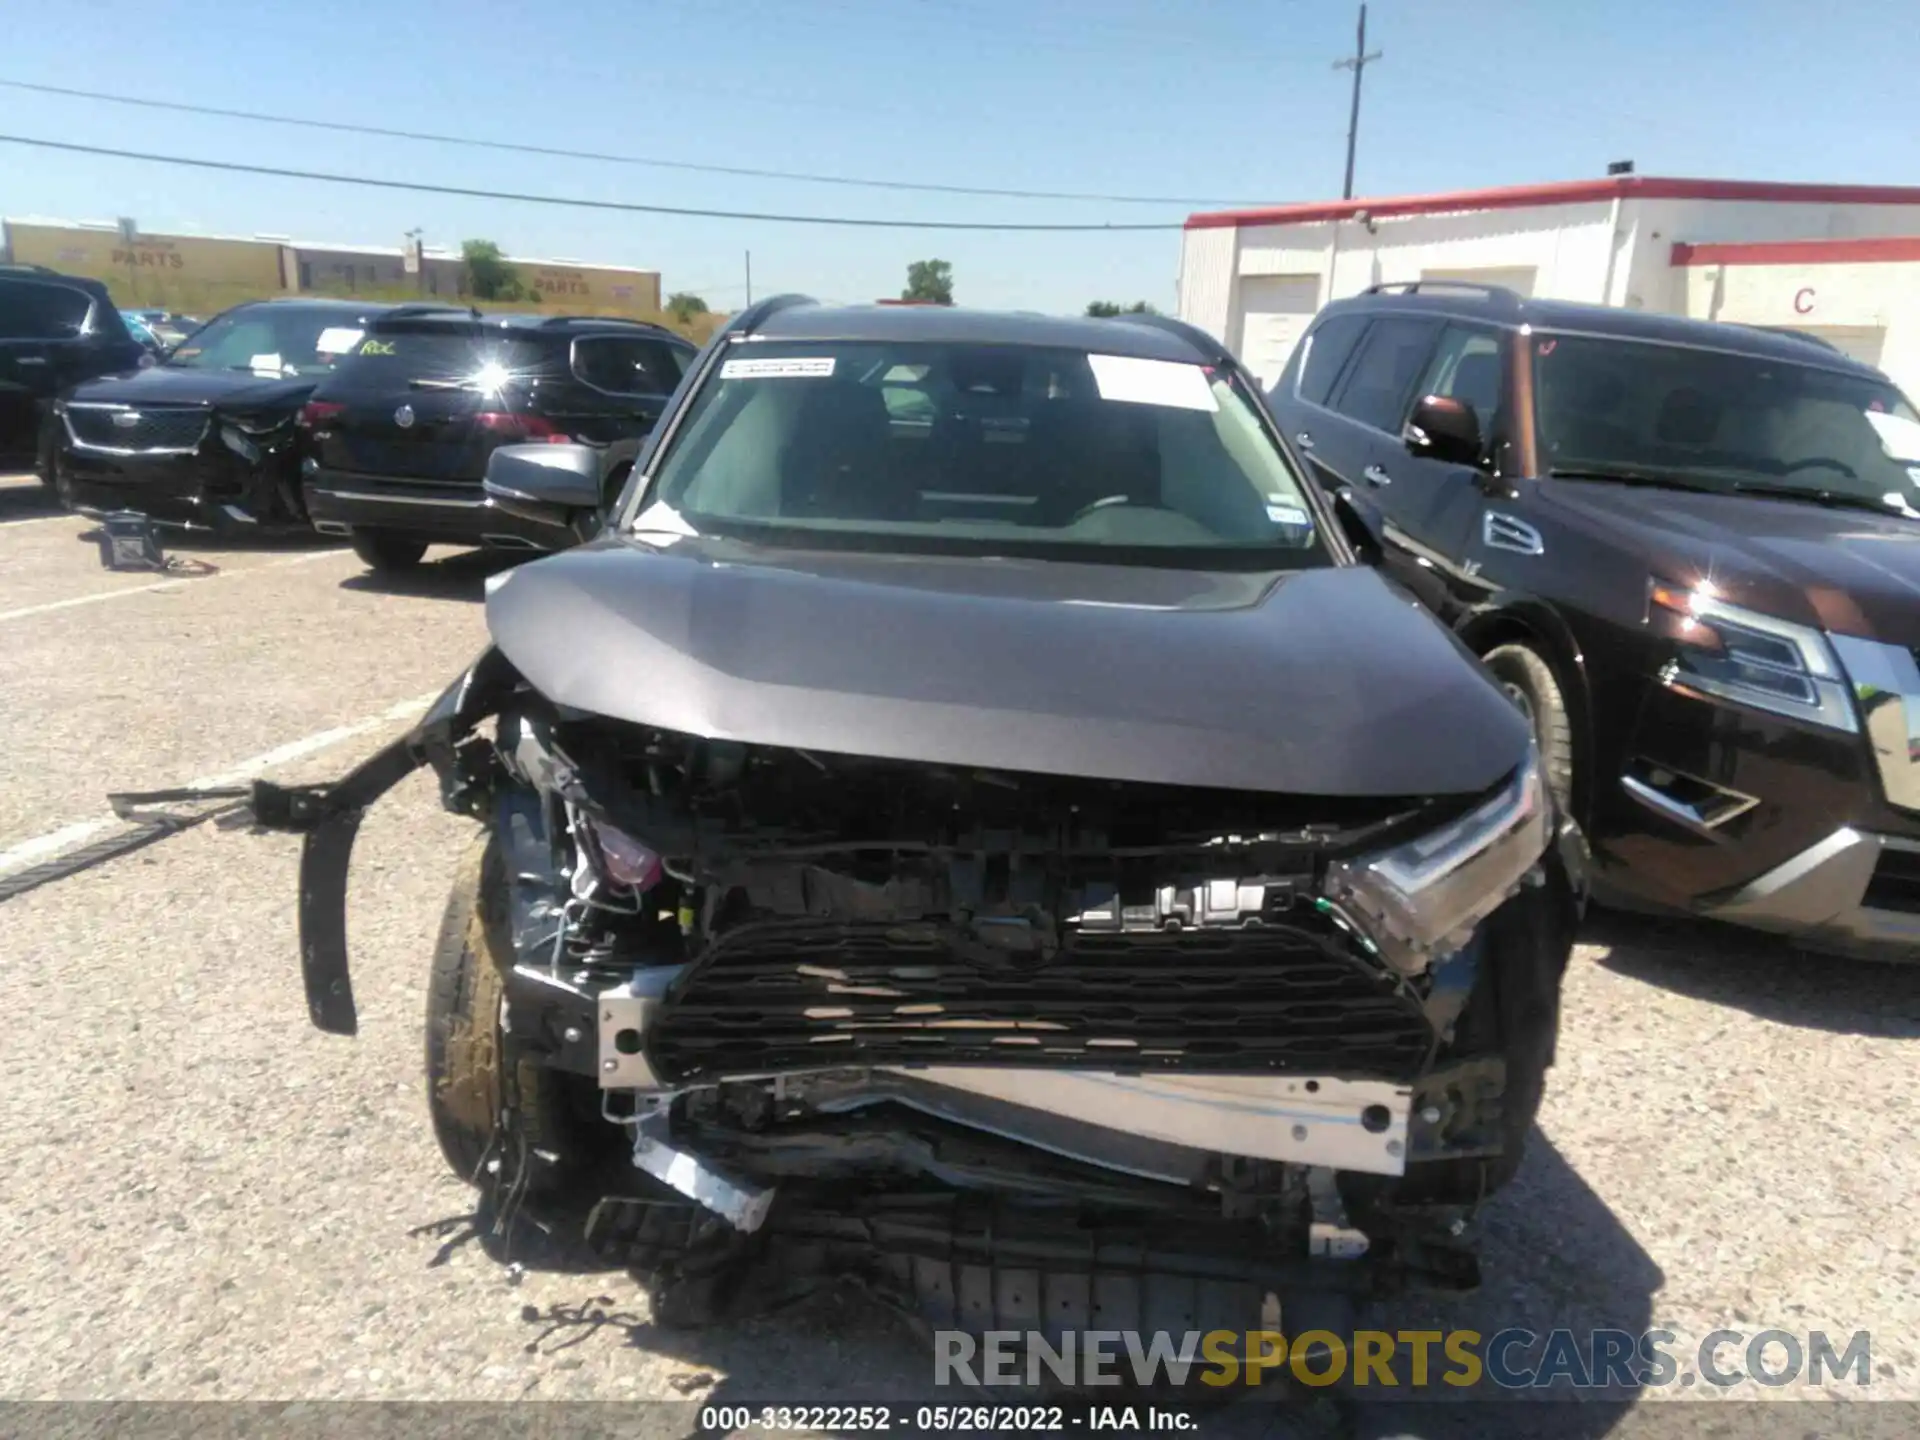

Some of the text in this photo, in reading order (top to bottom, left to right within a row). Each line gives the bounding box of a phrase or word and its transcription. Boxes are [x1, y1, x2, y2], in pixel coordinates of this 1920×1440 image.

[111, 249, 184, 269] PARTS
[533, 277, 591, 295] PARTS
[1794, 287, 1816, 314] C
